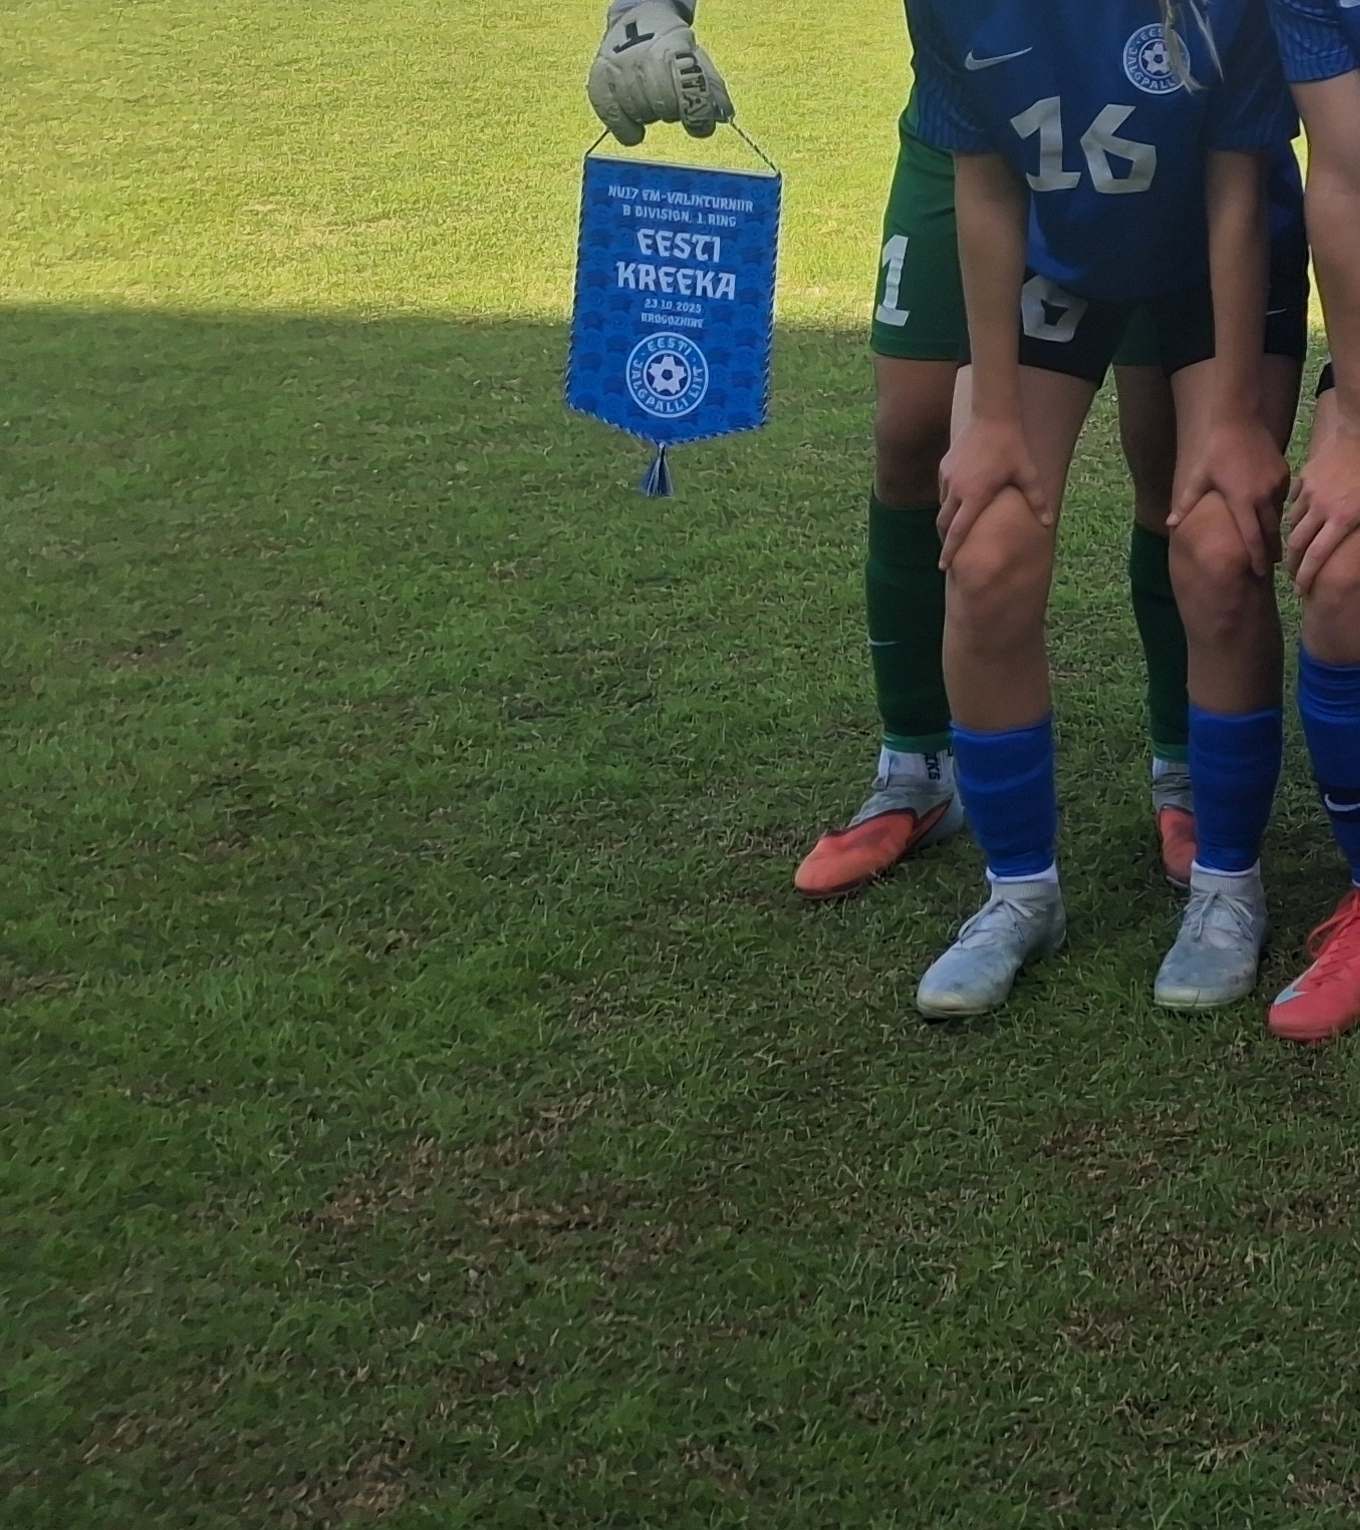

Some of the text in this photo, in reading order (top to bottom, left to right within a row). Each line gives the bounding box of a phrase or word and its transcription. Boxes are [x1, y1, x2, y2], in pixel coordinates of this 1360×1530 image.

[1010, 95, 1157, 194] 16
[608, 184, 639, 200] NU17
[622, 204, 632, 216] B
[637, 228, 722, 263] EESTI
[616, 261, 737, 300] KREEKA
[875, 234, 910, 327] 1
[647, 337, 693, 356] EESTI
[631, 359, 689, 413] JALGPALLI
